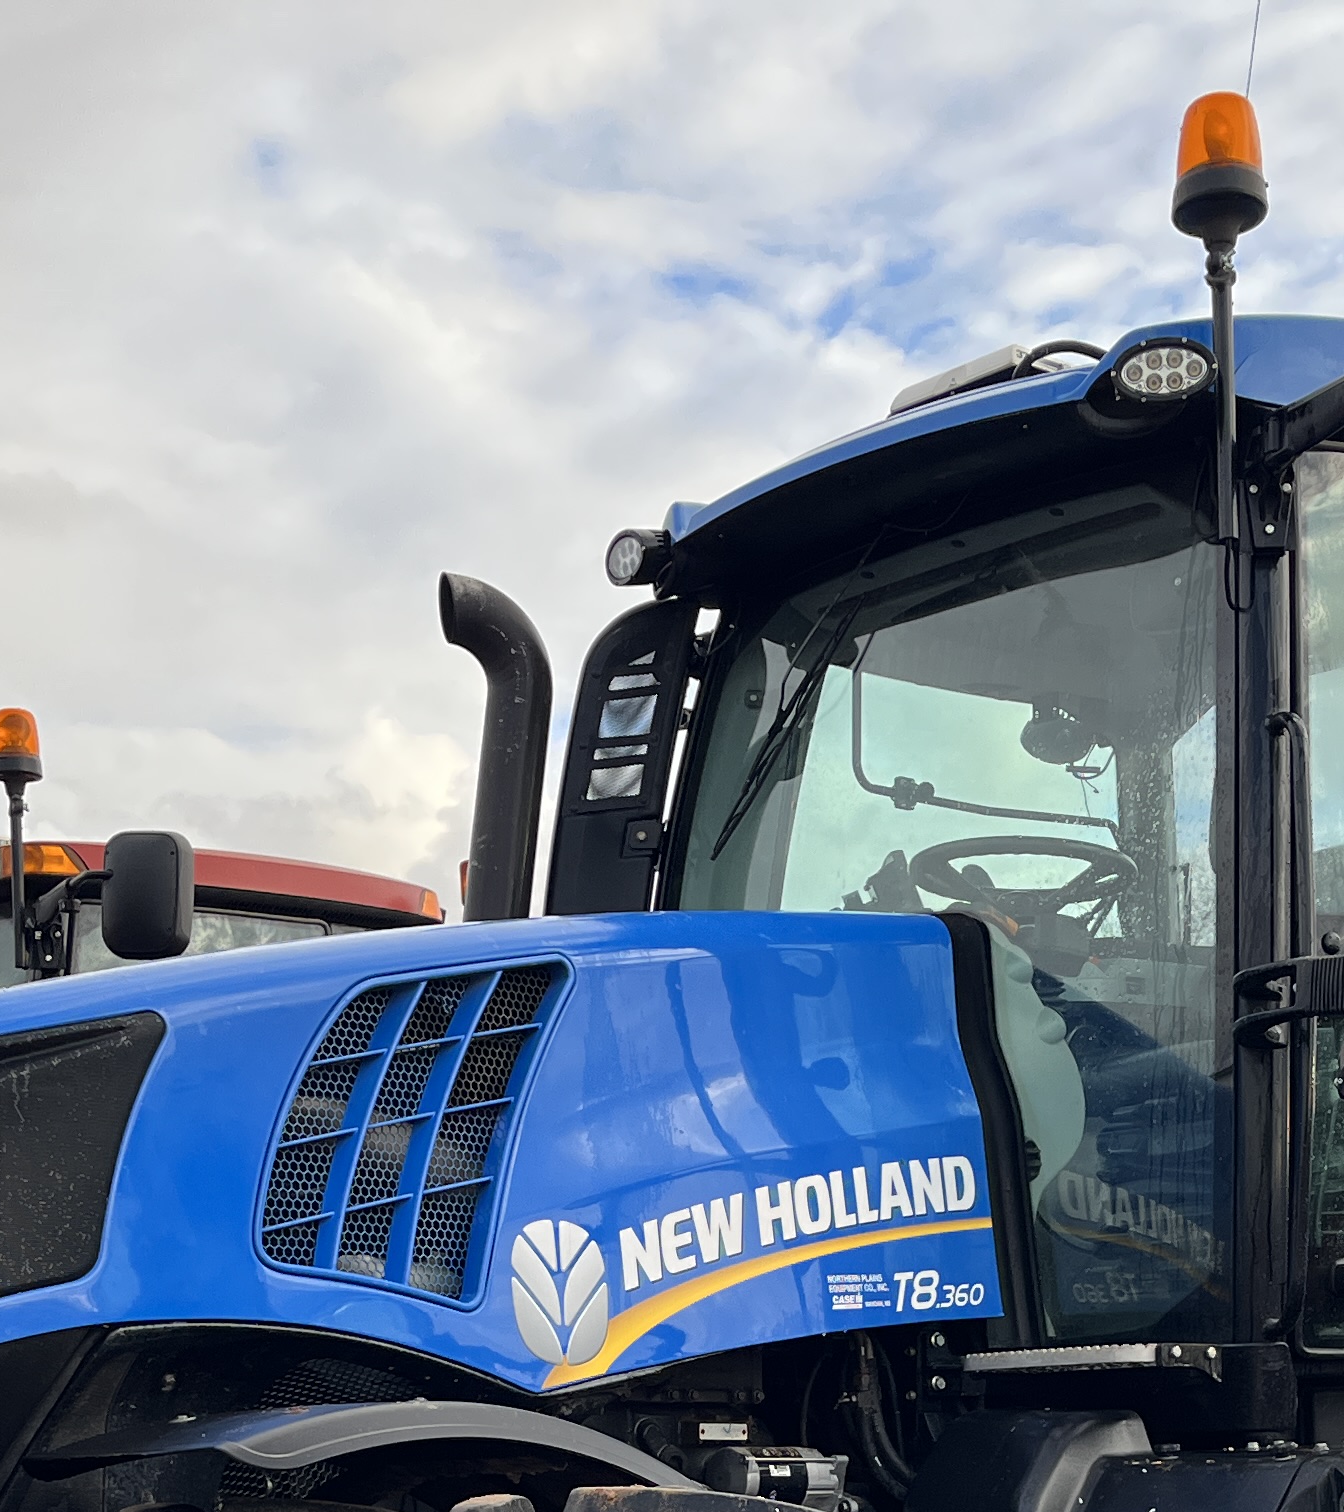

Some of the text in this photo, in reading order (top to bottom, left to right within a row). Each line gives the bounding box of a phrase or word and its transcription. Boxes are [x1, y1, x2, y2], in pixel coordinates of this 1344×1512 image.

[619, 1155, 976, 1291] NEW HOLLAND
[832, 1295, 854, 1304] CASE
